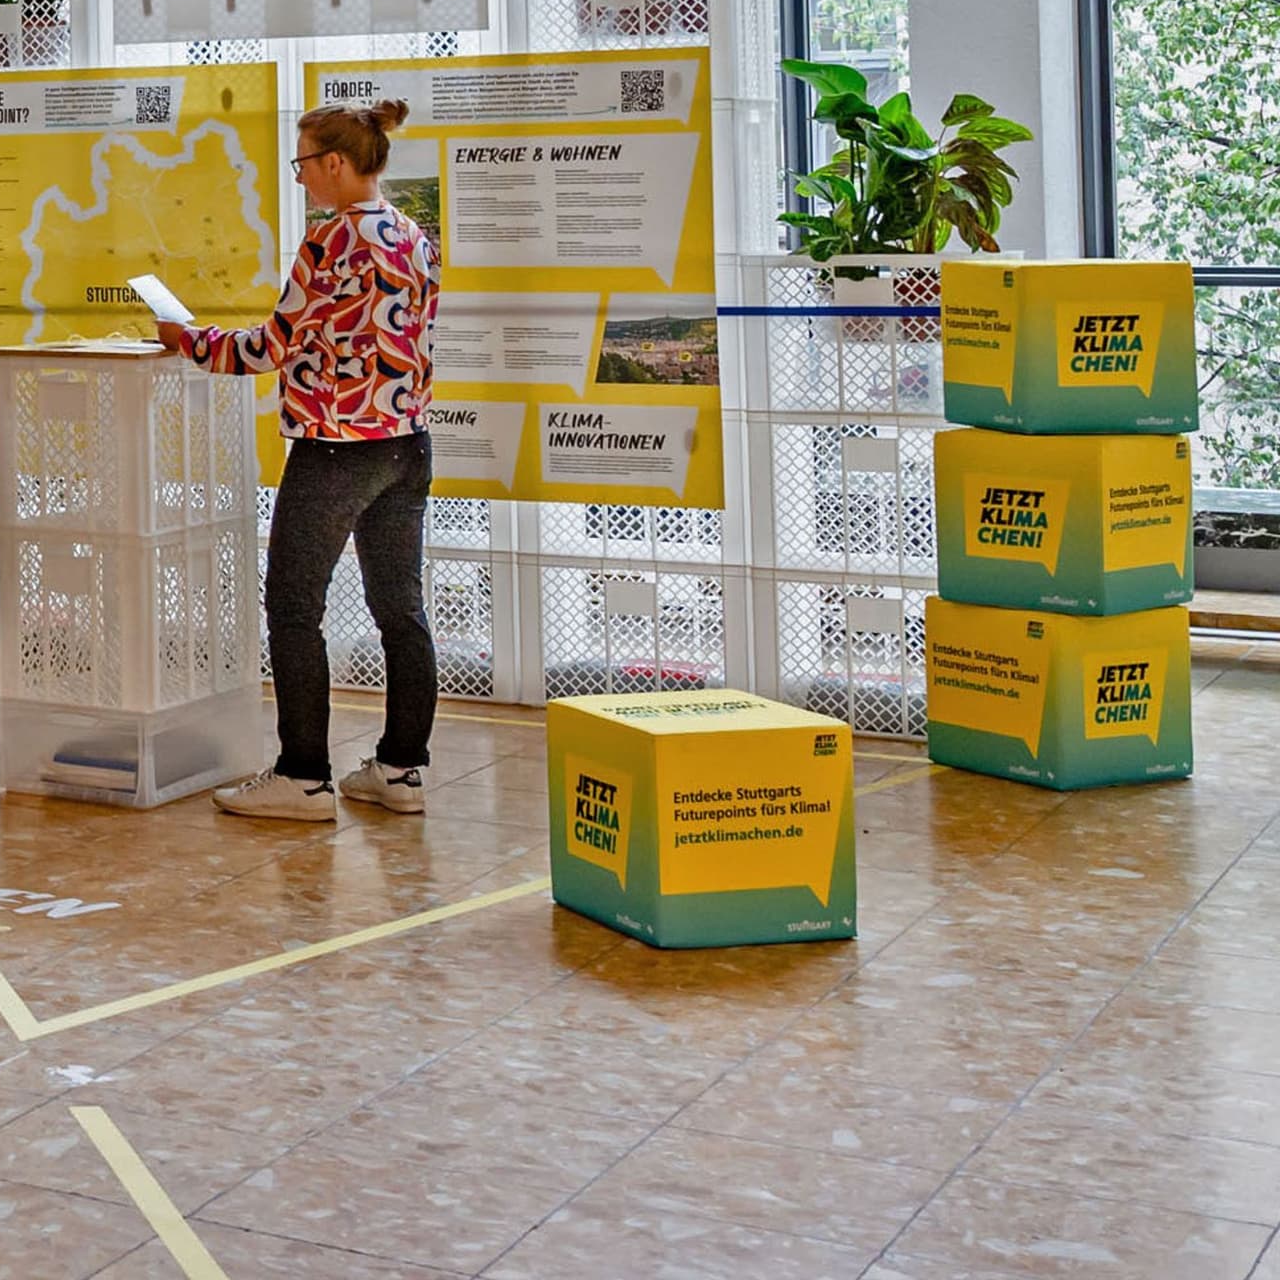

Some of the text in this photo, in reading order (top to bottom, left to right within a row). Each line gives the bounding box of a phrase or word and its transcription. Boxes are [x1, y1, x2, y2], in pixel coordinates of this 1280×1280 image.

[454, 144, 623, 164] ENERGIE & WOHNEN
[1073, 314, 1140, 333] JETZT
[1073, 334, 1143, 352] KLIMA
[1070, 355, 1138, 373] CHEN!
[547, 412, 612, 430] KLIMA-
[548, 432, 666, 451] INNOVATIONEN
[980, 487, 1045, 508] JETZT
[980, 507, 1048, 529] KLIMA
[977, 526, 1043, 548] CHEN!
[1096, 662, 1149, 684] JETZT
[1096, 683, 1152, 704] KLIMA
[1094, 703, 1148, 724] CHEN!
[575, 773, 618, 805] JETZT
[673, 785, 802, 804] Entdecke Stuttgarts
[575, 797, 620, 832] KLIMA
[673, 800, 832, 824] Futurepoints fürs Klima!
[574, 820, 617, 855] CHEN!
[674, 825, 804, 848] jetztklimachen.de
